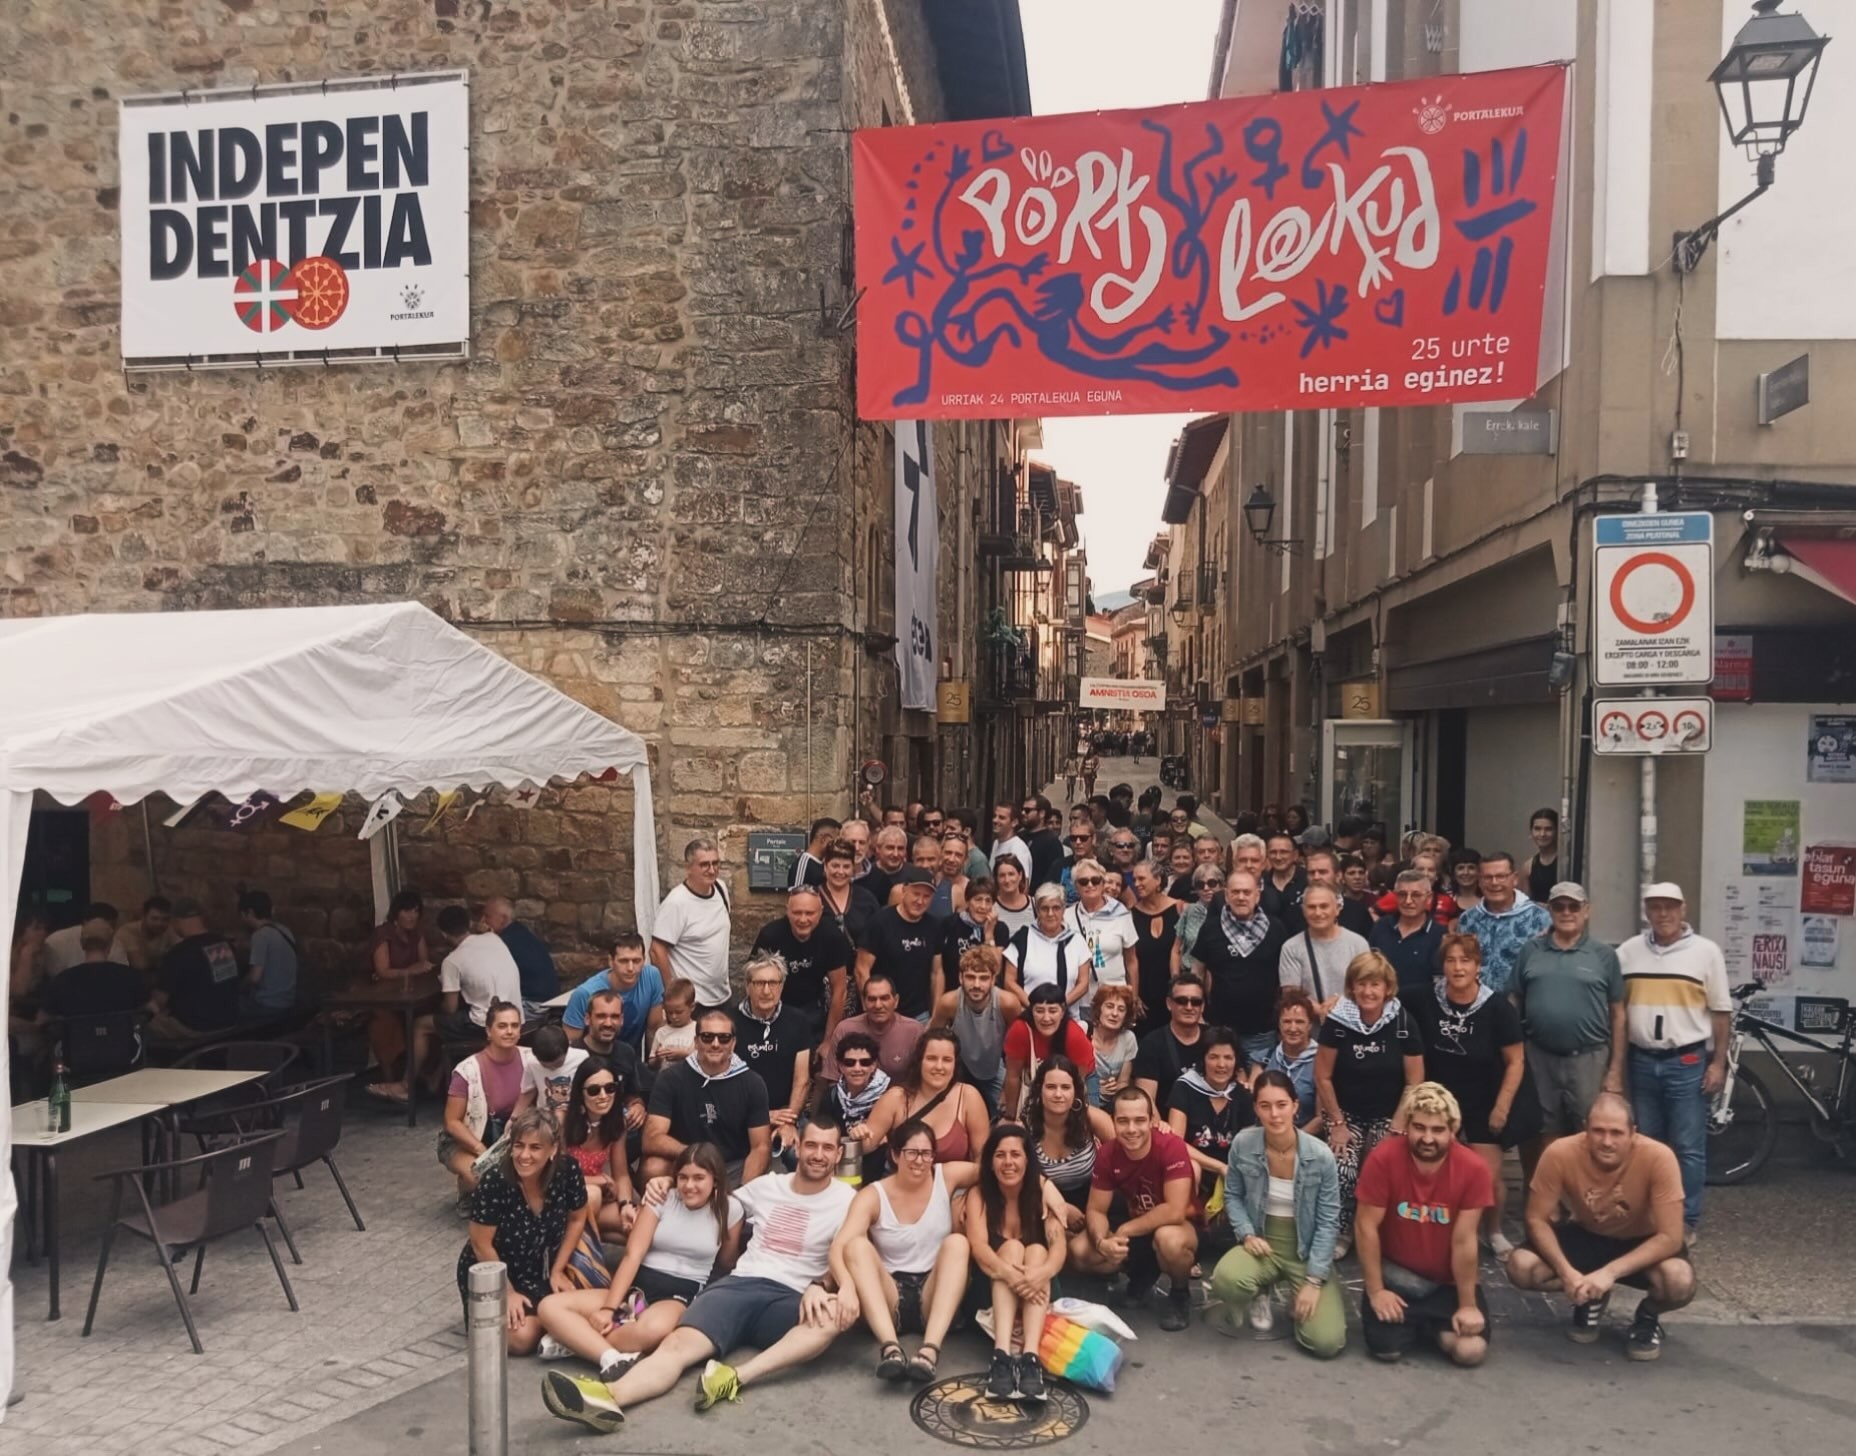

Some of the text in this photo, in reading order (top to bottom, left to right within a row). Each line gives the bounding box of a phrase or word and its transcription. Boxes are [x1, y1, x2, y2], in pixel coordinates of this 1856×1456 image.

[1453, 106, 1524, 122] PORTALEKUA
[148, 111, 429, 204] INDEPEN
[149, 191, 432, 281] DENTZIA
[390, 311, 434, 321] PORTALEKUA
[1411, 333, 1511, 361] 25 urte
[1299, 361, 1505, 393] herria eginez!
[941, 389, 1122, 405] URRIAK 24 PORTALEKUA EGUNA
[1518, 419, 1540, 431] kale
[1658, 637, 1676, 645] IZAN
[1604, 649, 1701, 660] EXCEPTO CARGA Y DESCARGA
[1626, 661, 1649, 670] 08:00
[1656, 660, 1679, 669] 12:00
[946, 692, 962, 706] 25
[1131, 690, 1157, 698] OSOA
[1352, 695, 1371, 711] 25
[1809, 863, 1846, 874] tasun
[1813, 873, 1855, 886] eguna
